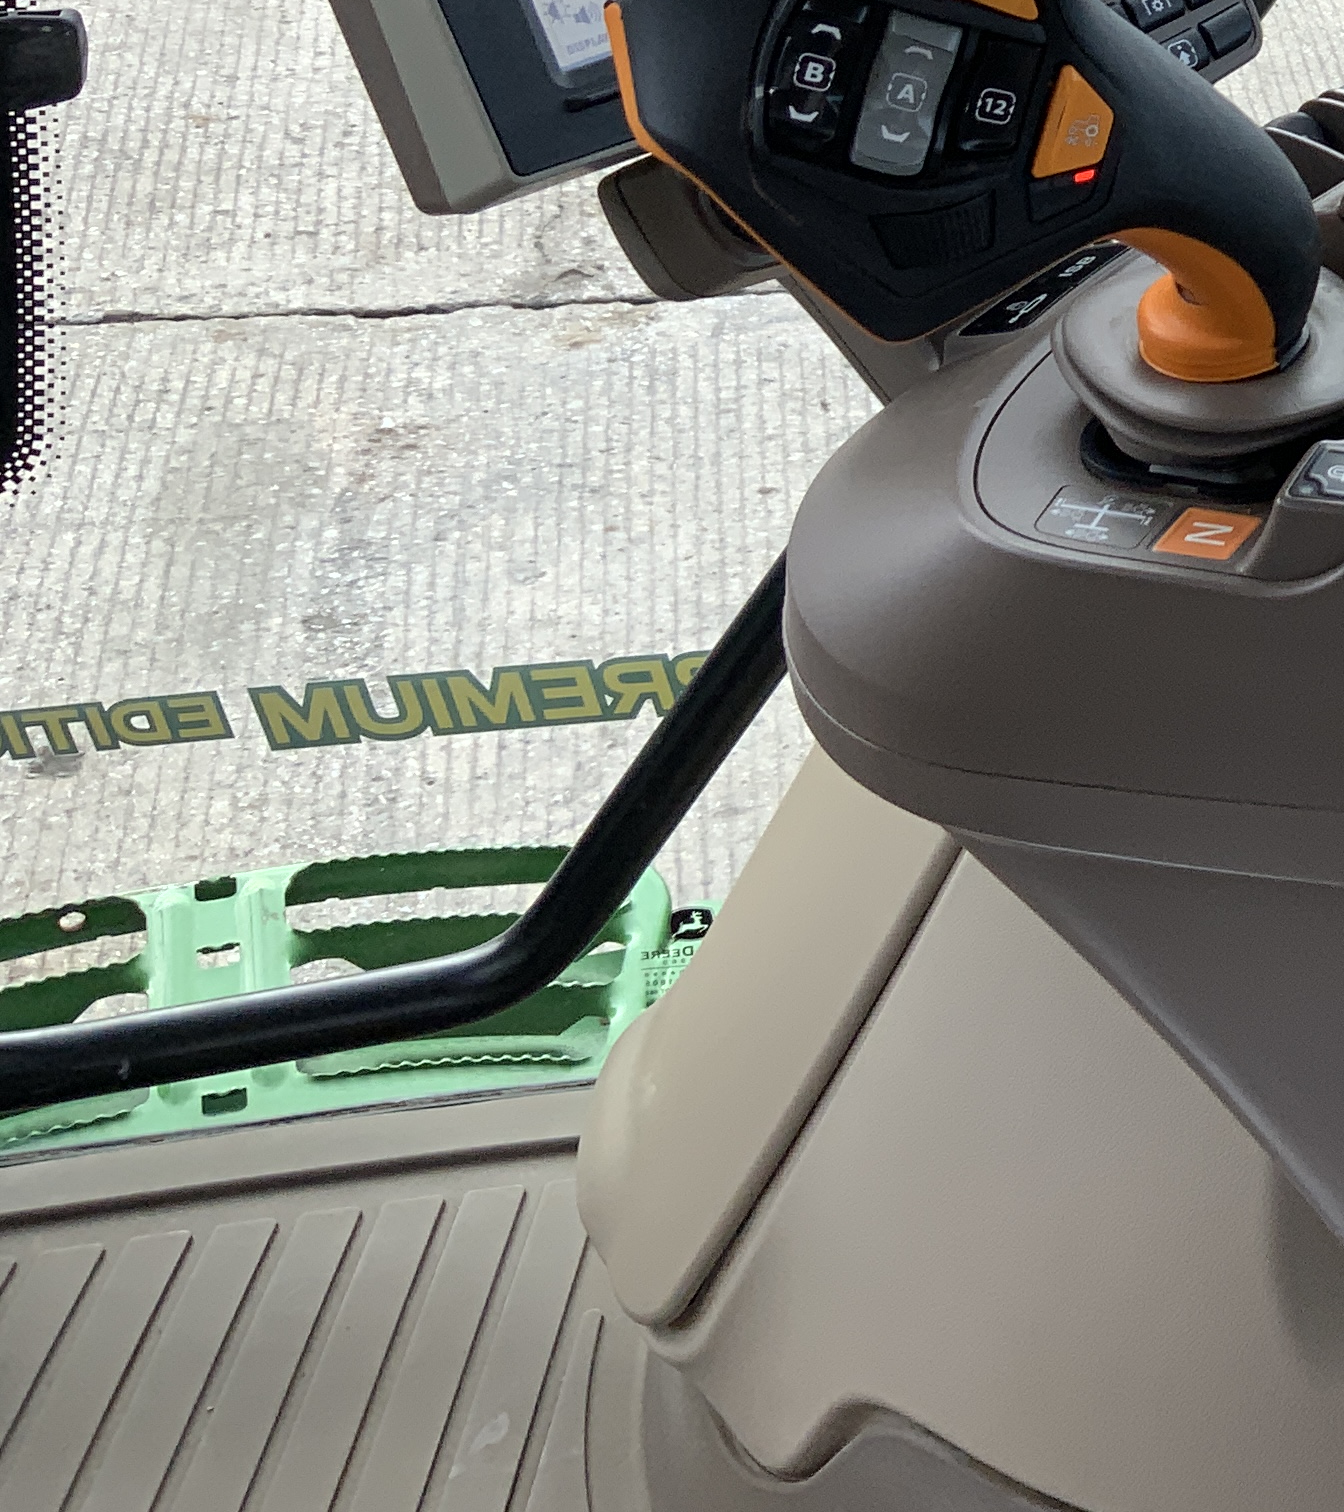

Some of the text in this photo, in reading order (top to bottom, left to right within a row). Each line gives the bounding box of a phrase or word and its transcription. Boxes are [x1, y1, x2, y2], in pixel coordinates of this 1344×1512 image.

[566, 33, 608, 56] DISPLA
[804, 64, 826, 82] B
[897, 83, 916, 104] A
[985, 97, 1008, 117] 12
[1183, 521, 1235, 546] N
